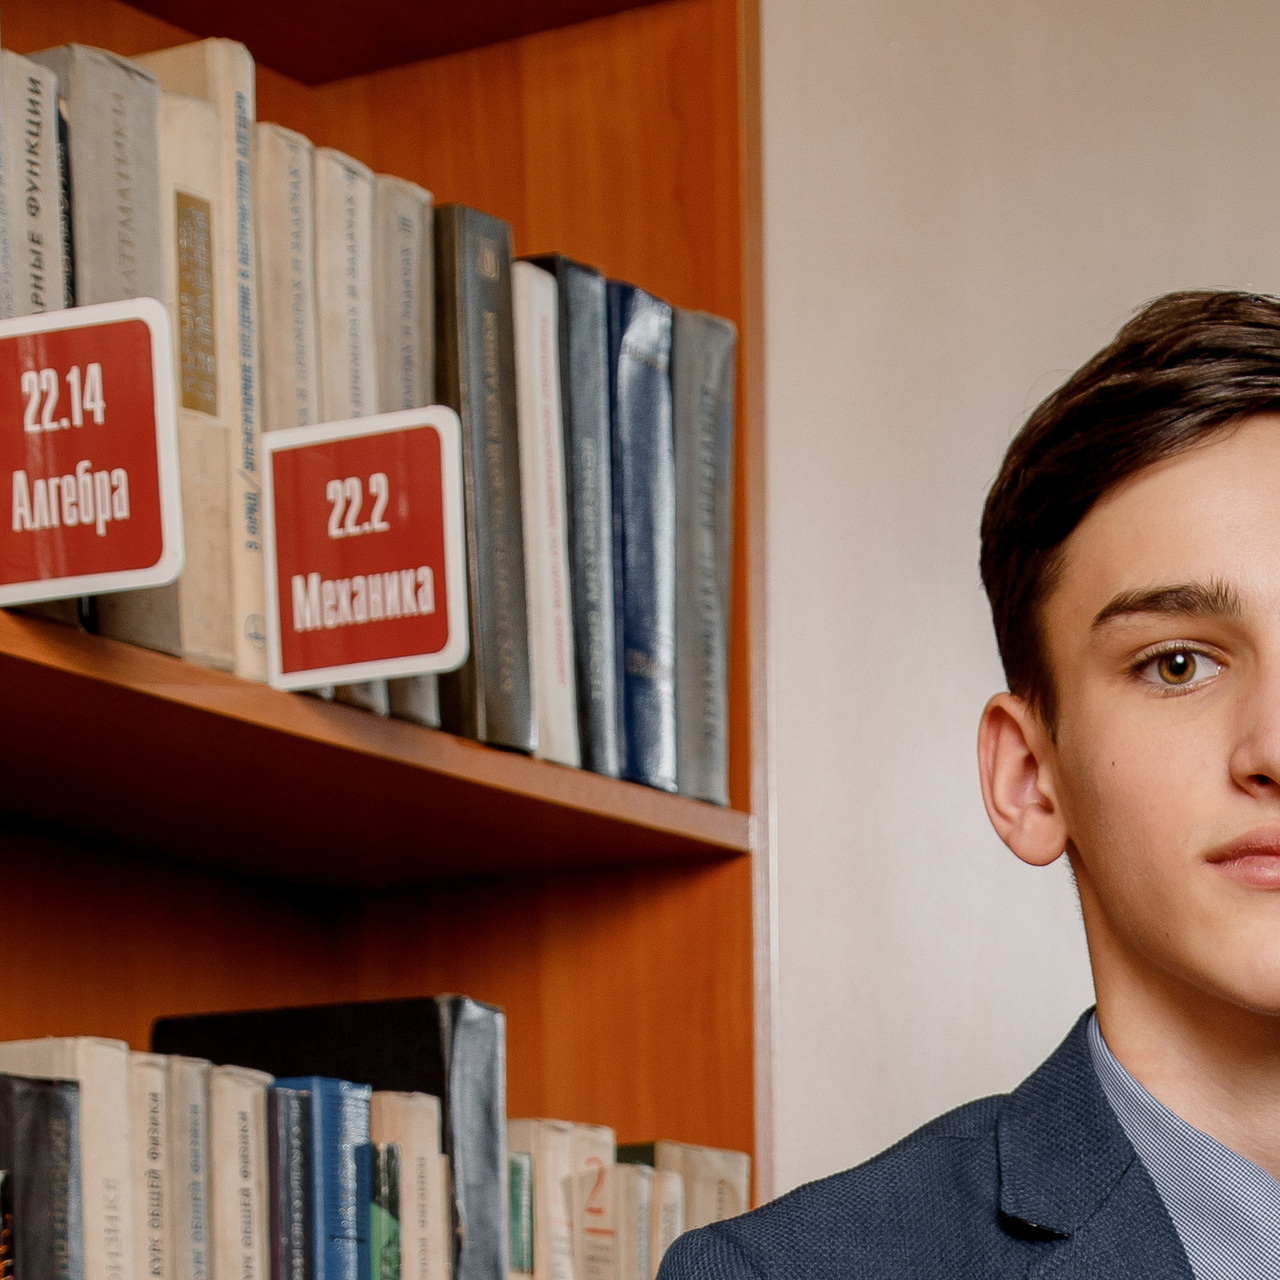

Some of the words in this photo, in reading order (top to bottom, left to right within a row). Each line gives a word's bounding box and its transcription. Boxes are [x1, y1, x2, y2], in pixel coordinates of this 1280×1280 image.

[24, 76, 44, 218] ФУНКЦИИ
[26, 230, 48, 316] РНЫЕ
[21, 362, 107, 434] 22.14
[11, 460, 130, 536] Алгебра
[326, 471, 391, 540] 22.2
[291, 562, 435, 634] Механика
[145, 1091, 161, 1161] ФИЗИКИ
[236, 1110, 251, 1180] ФИЗИКИ
[144, 1168, 162, 1230] ОБЩЕЙ
[584, 1156, 607, 1216] 2
[148, 1237, 163, 1278] КУРС
